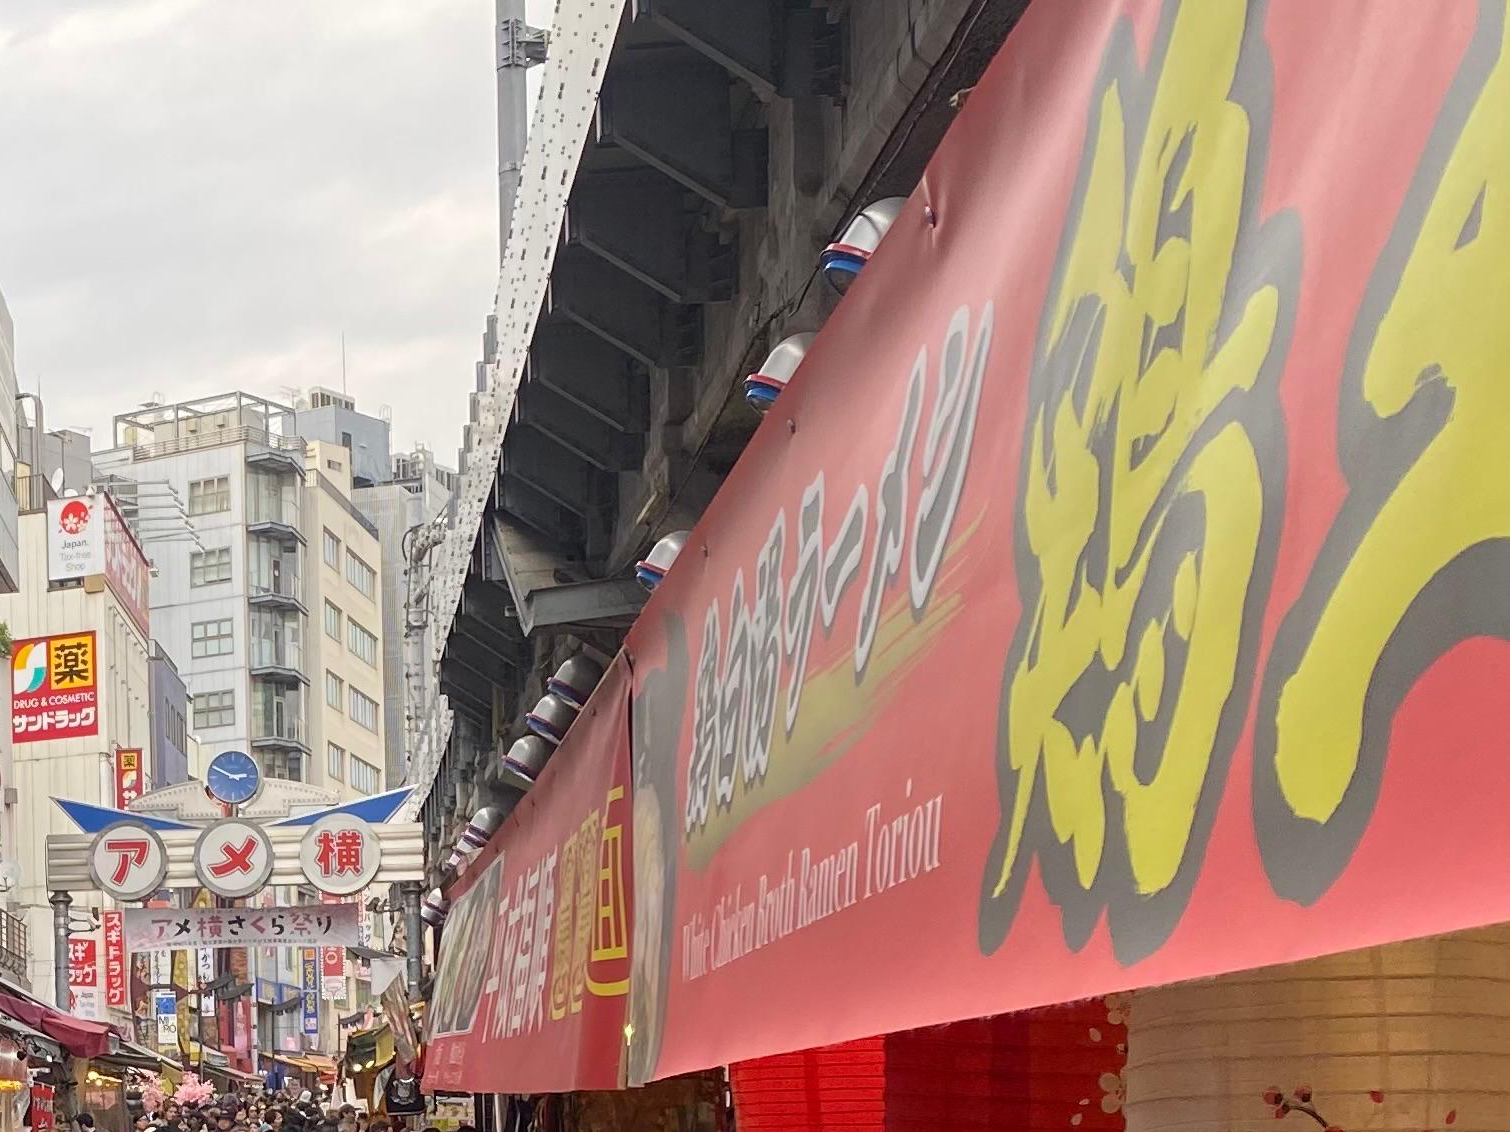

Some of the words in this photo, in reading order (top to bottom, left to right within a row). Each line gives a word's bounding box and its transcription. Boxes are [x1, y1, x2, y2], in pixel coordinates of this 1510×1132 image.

[54, 641, 89, 685] 薬
[13, 696, 39, 710] DRUG
[41, 695, 48, 707] &
[49, 691, 95, 707] COSMETIC
[13, 707, 96, 734] サンドラッグ
[104, 829, 365, 886] アメ横
[755, 850, 794, 949] Broth
[796, 841, 858, 930] Ramen
[862, 778, 943, 900] Toriou
[151, 912, 332, 939] アメ横さくら祭り
[106, 912, 124, 1005] スギドラッグ
